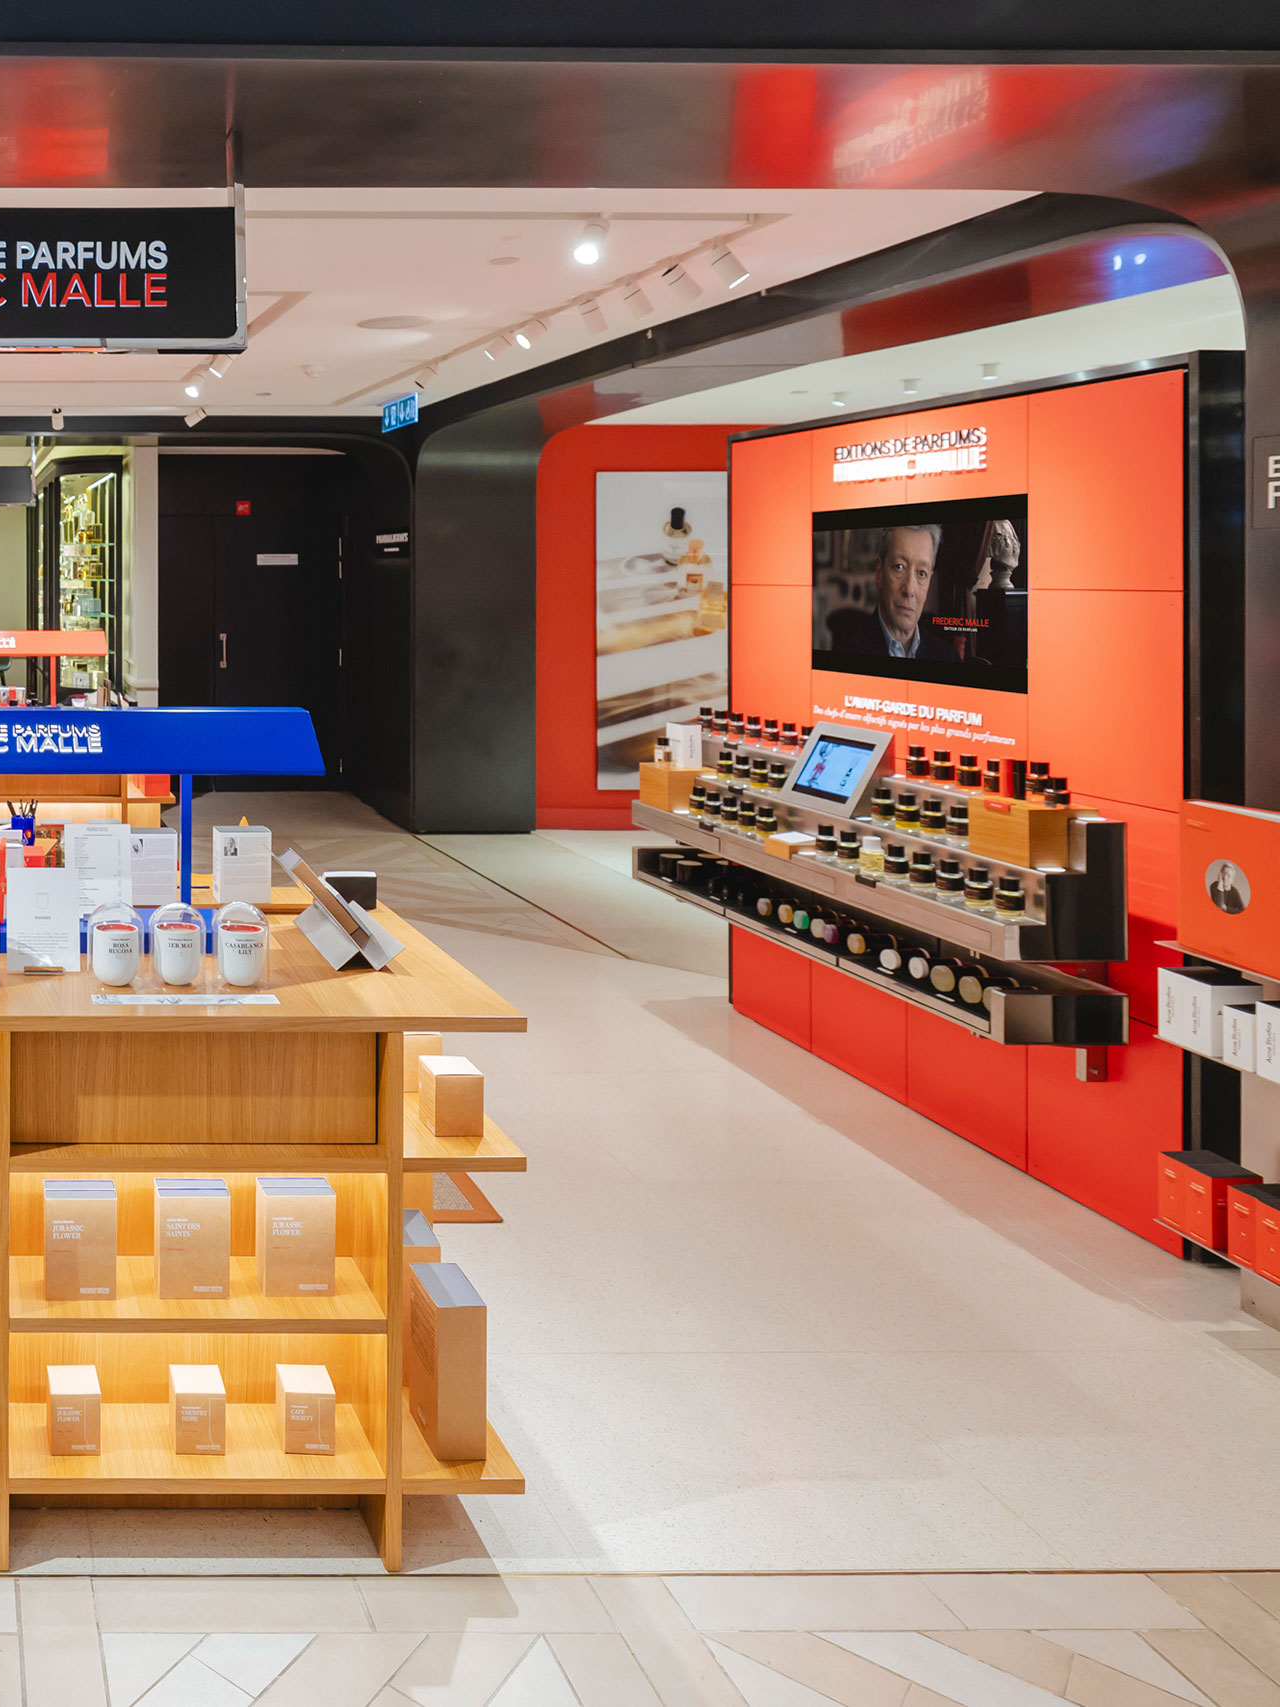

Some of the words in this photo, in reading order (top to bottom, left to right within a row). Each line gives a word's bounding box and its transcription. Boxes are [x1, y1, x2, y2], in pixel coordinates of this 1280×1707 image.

[16, 240, 169, 270] PARFUMS
[22, 272, 168, 307] MALLE
[834, 440, 893, 462] EDITIONS
[894, 436, 915, 454] DE
[914, 427, 987, 452] PARFUMS
[932, 616, 964, 627] FREDERIC
[965, 618, 990, 628] MALLE
[844, 695, 918, 717] L'AVANT-GARDE
[919, 705, 935, 719] DU
[936, 708, 983, 727] PARFUM
[13, 723, 100, 737] PARFUMS
[813, 705, 824, 715] Des
[930, 724, 945, 736] plus
[946, 726, 971, 739] grands
[972, 731, 1016, 746] parfumeurs
[16, 736, 103, 753] MALLE
[166, 1230, 191, 1238] SAINTS
[272, 1221, 304, 1229] JURASSIC
